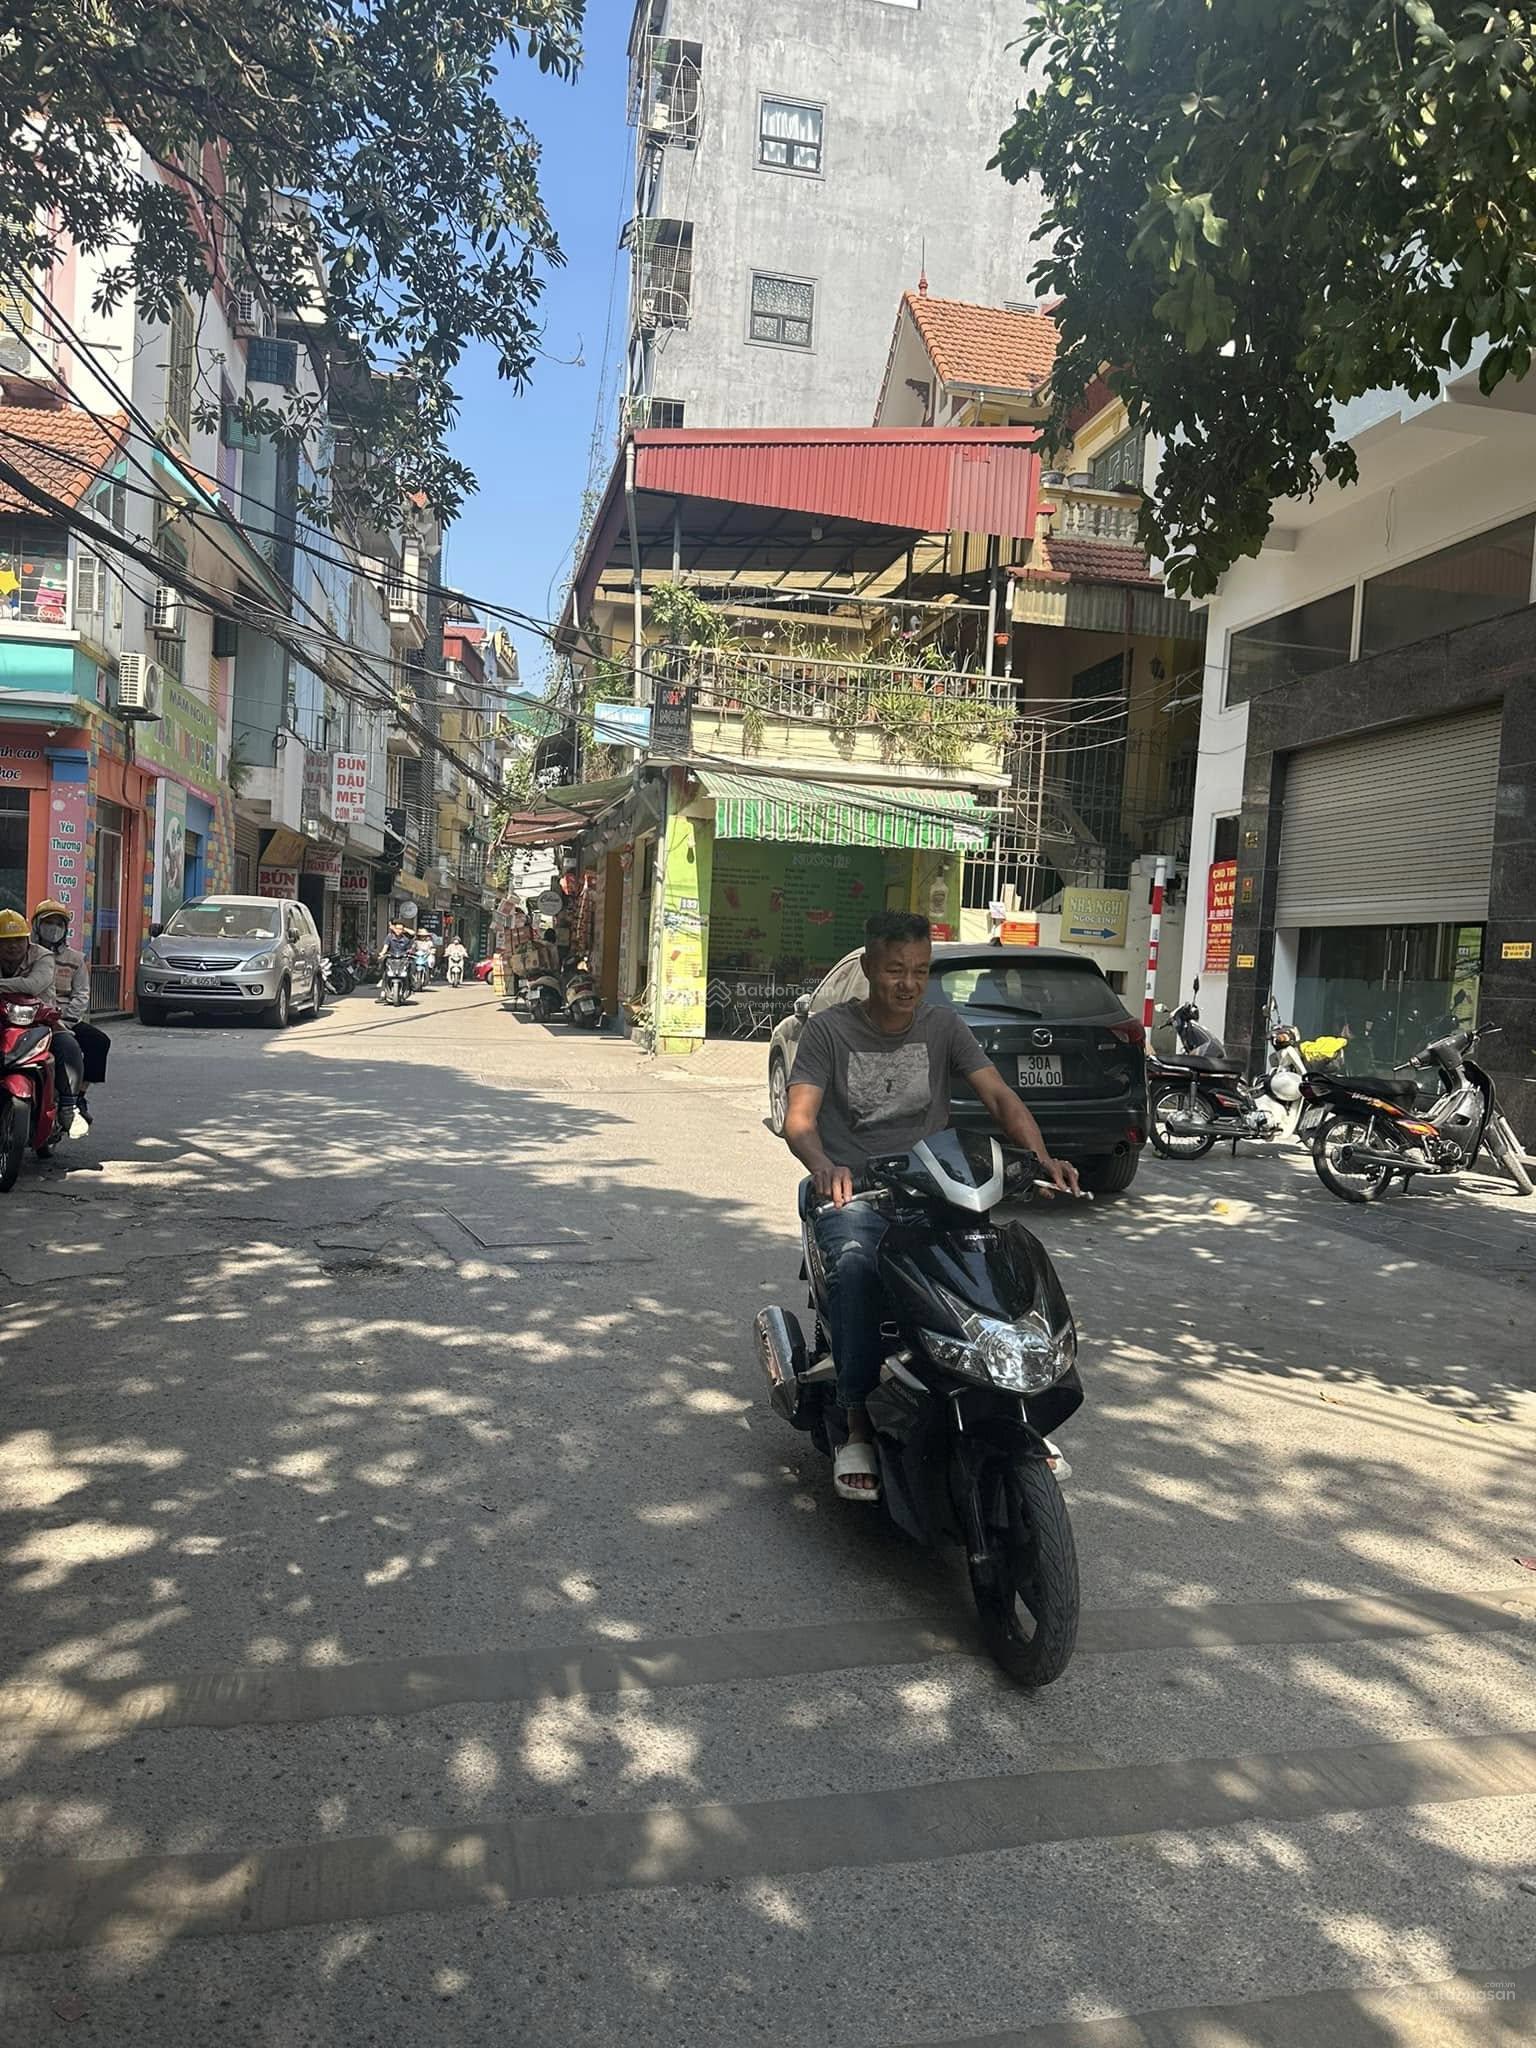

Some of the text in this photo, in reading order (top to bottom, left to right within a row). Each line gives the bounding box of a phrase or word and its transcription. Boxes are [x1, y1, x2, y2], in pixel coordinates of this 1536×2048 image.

[17, 748, 40, 760] cao
[337, 755, 366, 771] BÚN
[336, 773, 365, 789] ĐẬU
[336, 790, 366, 806] MẸT
[52, 838, 81, 852] Thương
[260, 869, 296, 886] BÚN
[1212, 868, 1226, 879] CHO
[340, 875, 368, 891] GẠO
[1028, 1056, 1052, 1071] 30A
[1020, 1071, 1062, 1086] 504.00
